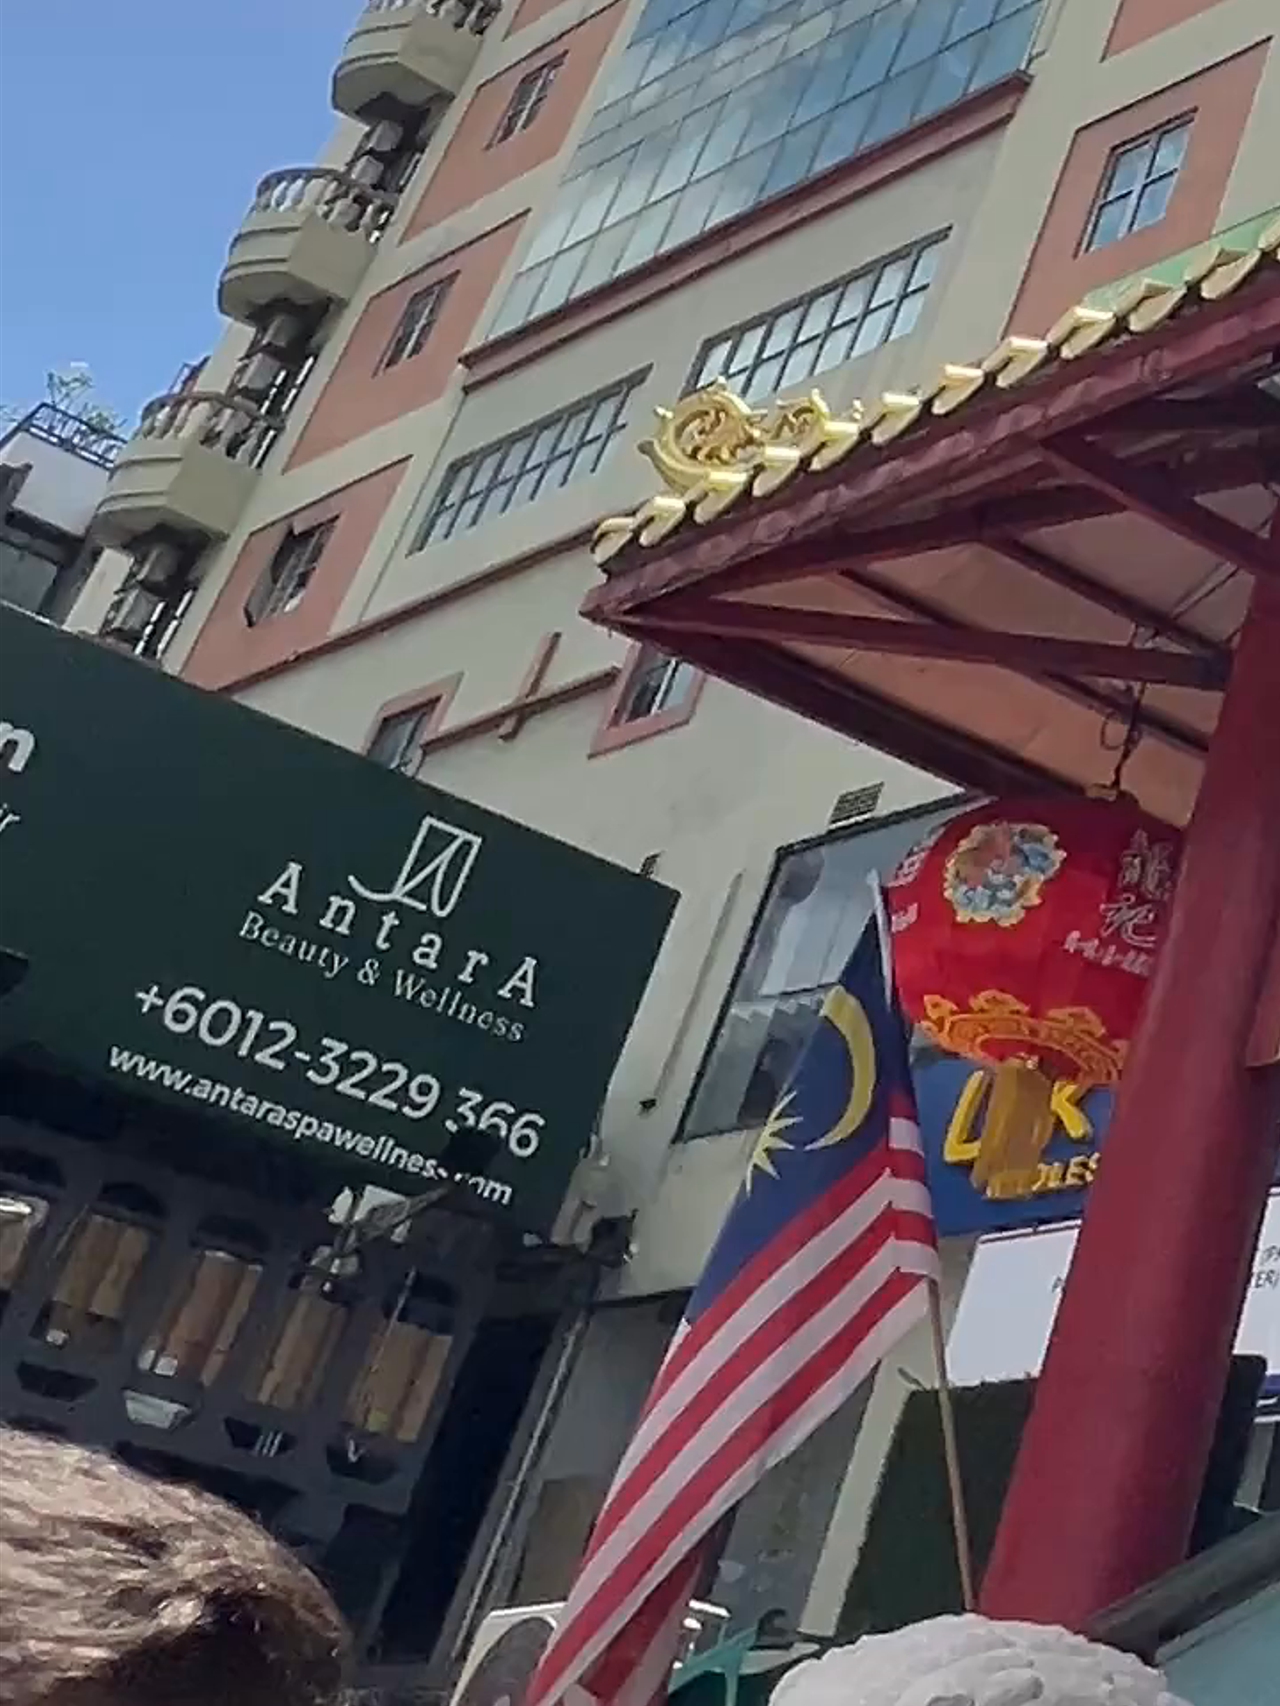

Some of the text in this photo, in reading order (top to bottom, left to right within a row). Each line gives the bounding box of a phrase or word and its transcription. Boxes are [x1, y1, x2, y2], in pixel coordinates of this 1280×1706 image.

[238, 910, 526, 1043] Beauty & Wellness
[135, 984, 441, 1119] +6012-3229
